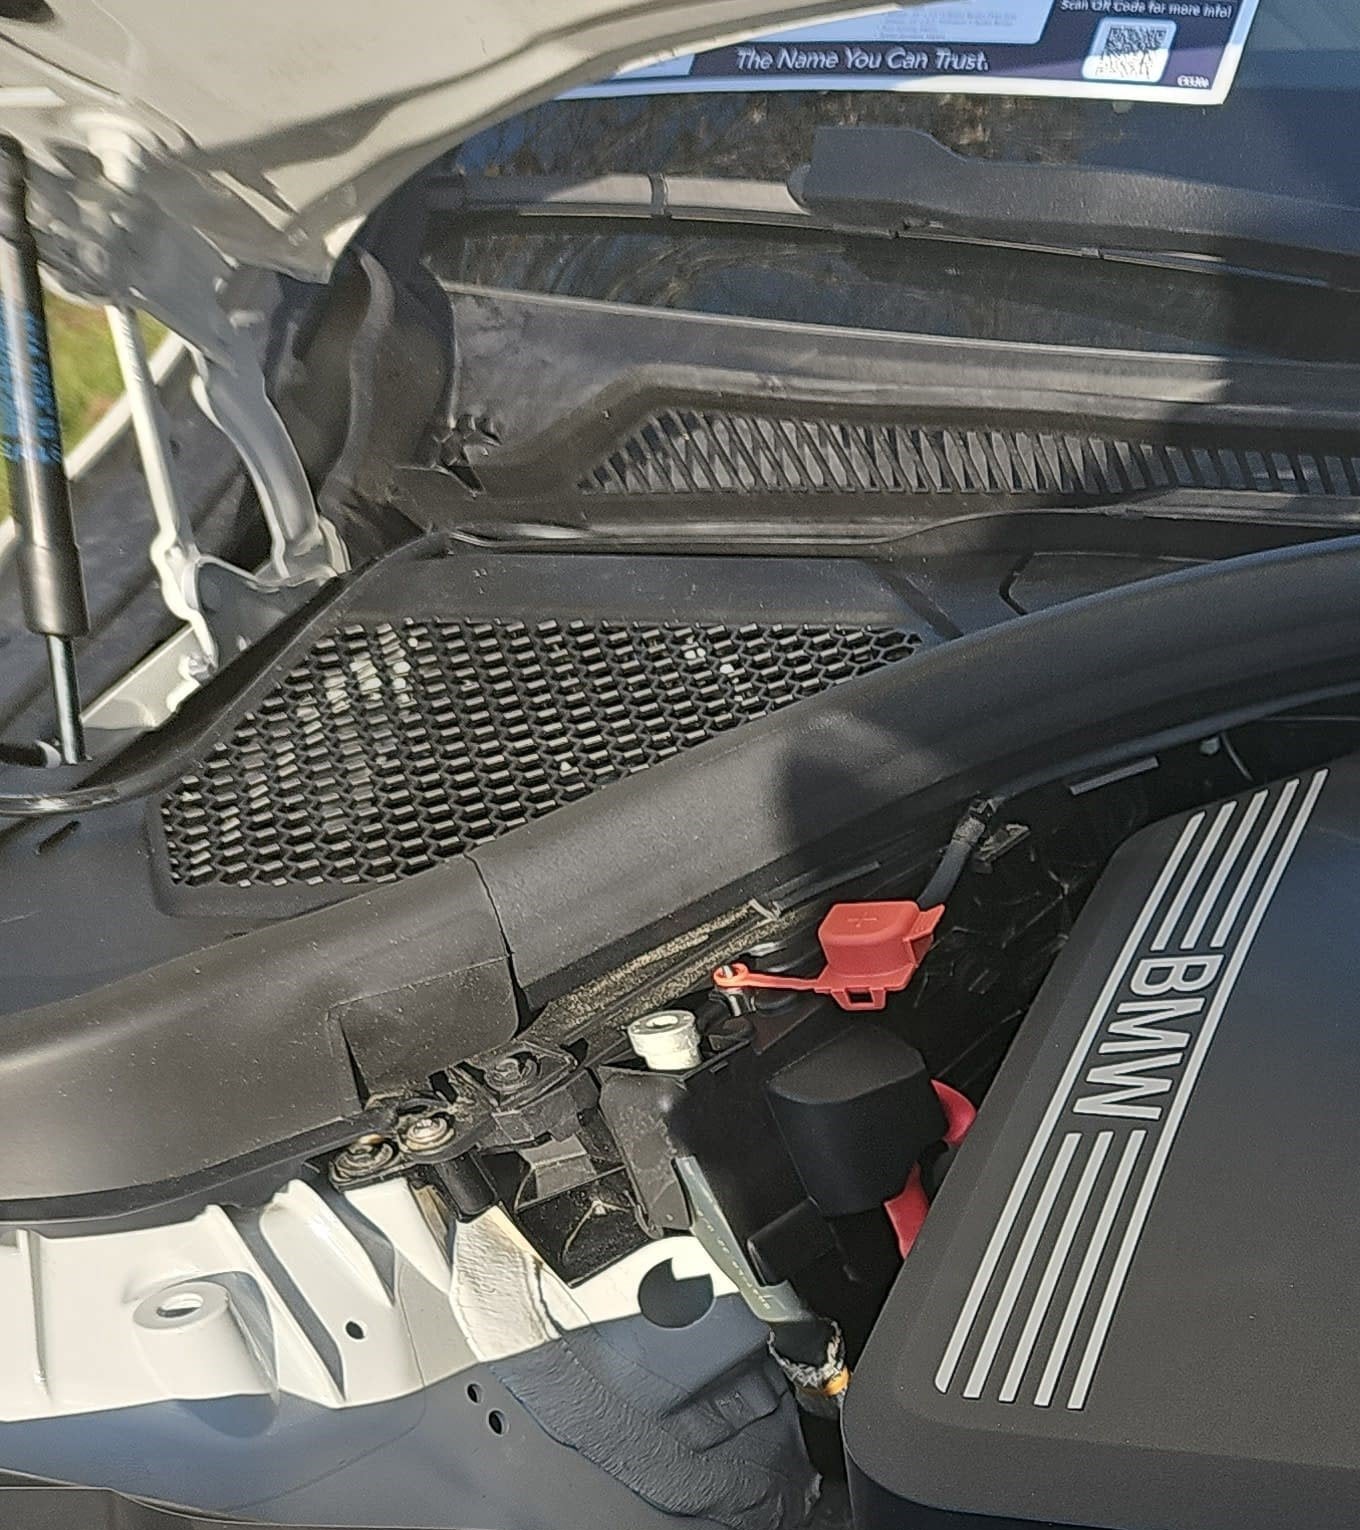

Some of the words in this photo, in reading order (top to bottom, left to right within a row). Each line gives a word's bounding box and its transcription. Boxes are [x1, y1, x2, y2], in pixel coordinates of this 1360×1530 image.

[1149, 2, 1166, 13] for
[1168, 4, 1201, 16] more
[736, 47, 773, 69] The
[777, 47, 839, 69] Name
[845, 47, 882, 69] You
[887, 48, 928, 70] Can
[1072, 952, 1226, 1122] BMW
